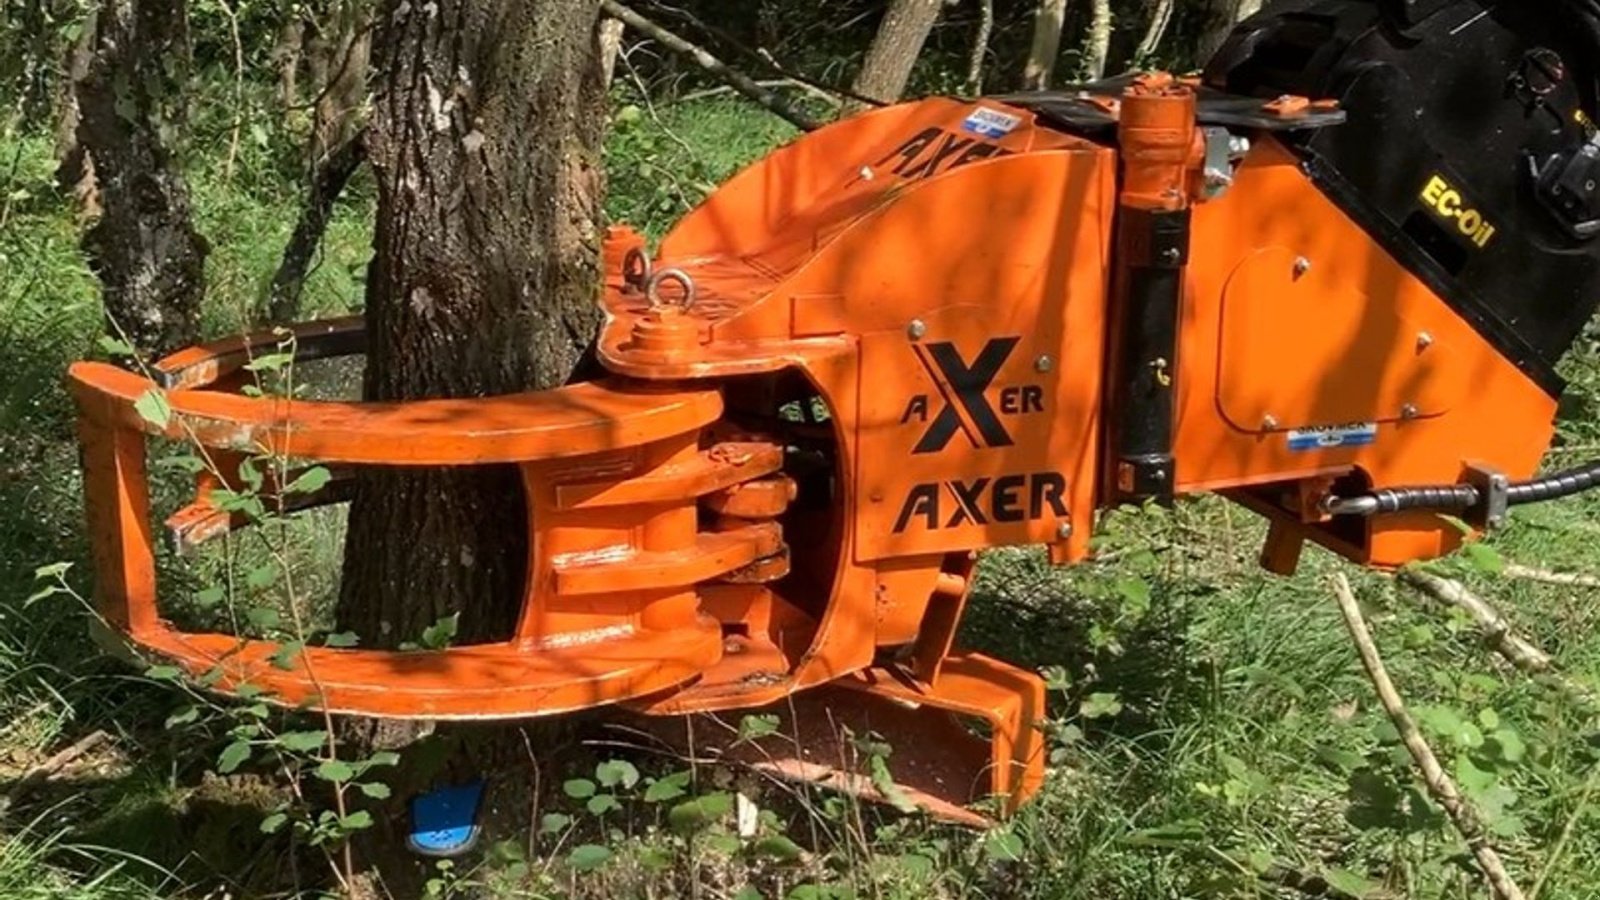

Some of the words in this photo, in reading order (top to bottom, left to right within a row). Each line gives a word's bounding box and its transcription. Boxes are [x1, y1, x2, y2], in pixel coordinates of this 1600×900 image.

[1421, 175, 1495, 248] EC-Oil
[901, 336, 1044, 454] AXER
[892, 472, 1069, 533] AXER
